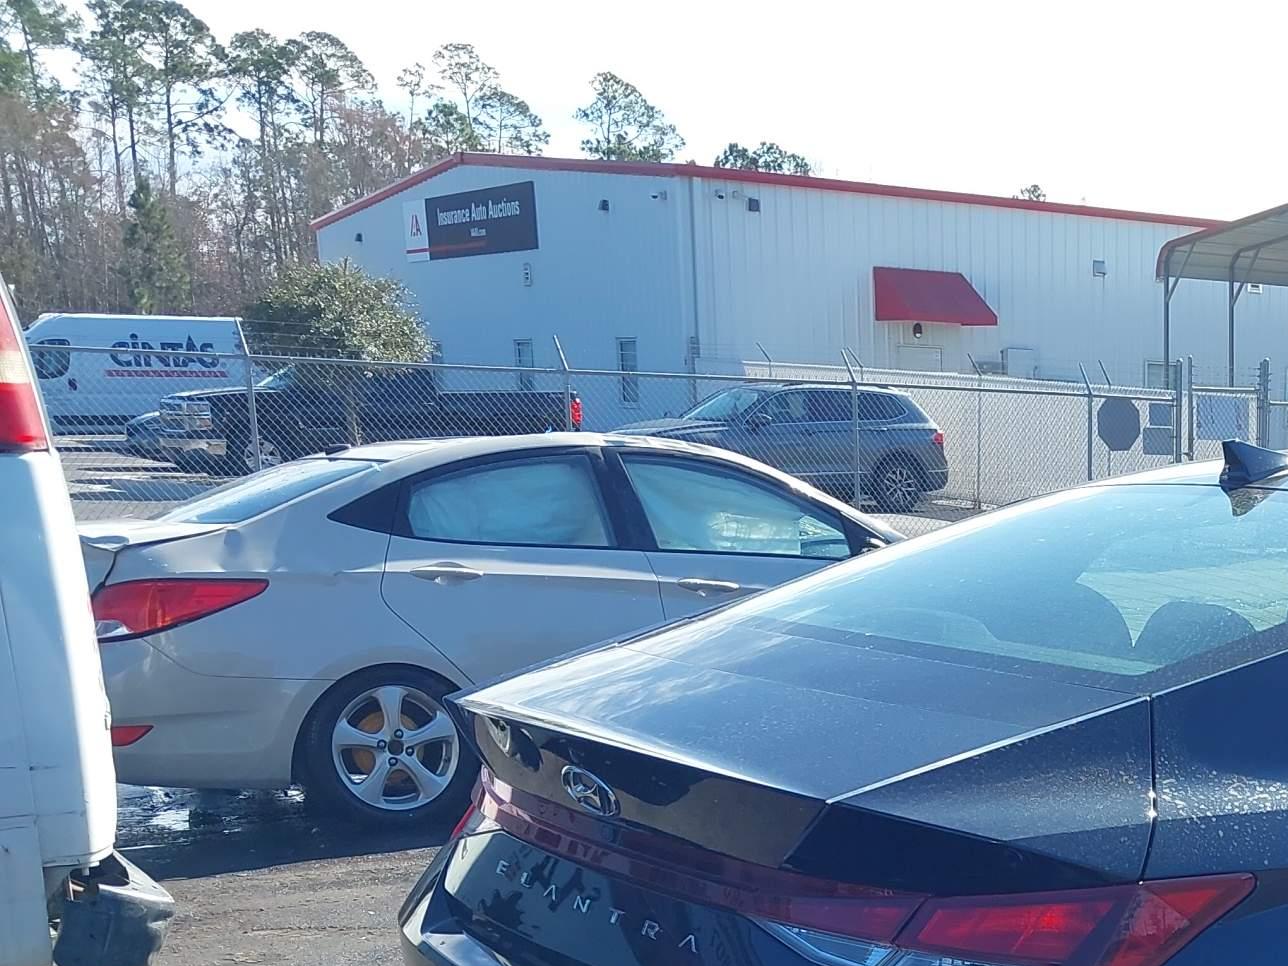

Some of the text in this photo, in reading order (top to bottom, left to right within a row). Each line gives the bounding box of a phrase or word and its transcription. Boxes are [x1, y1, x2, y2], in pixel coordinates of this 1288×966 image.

[437, 197, 520, 226] Insurance Auto Auctions
[496, 860, 698, 953] ELANTRA
